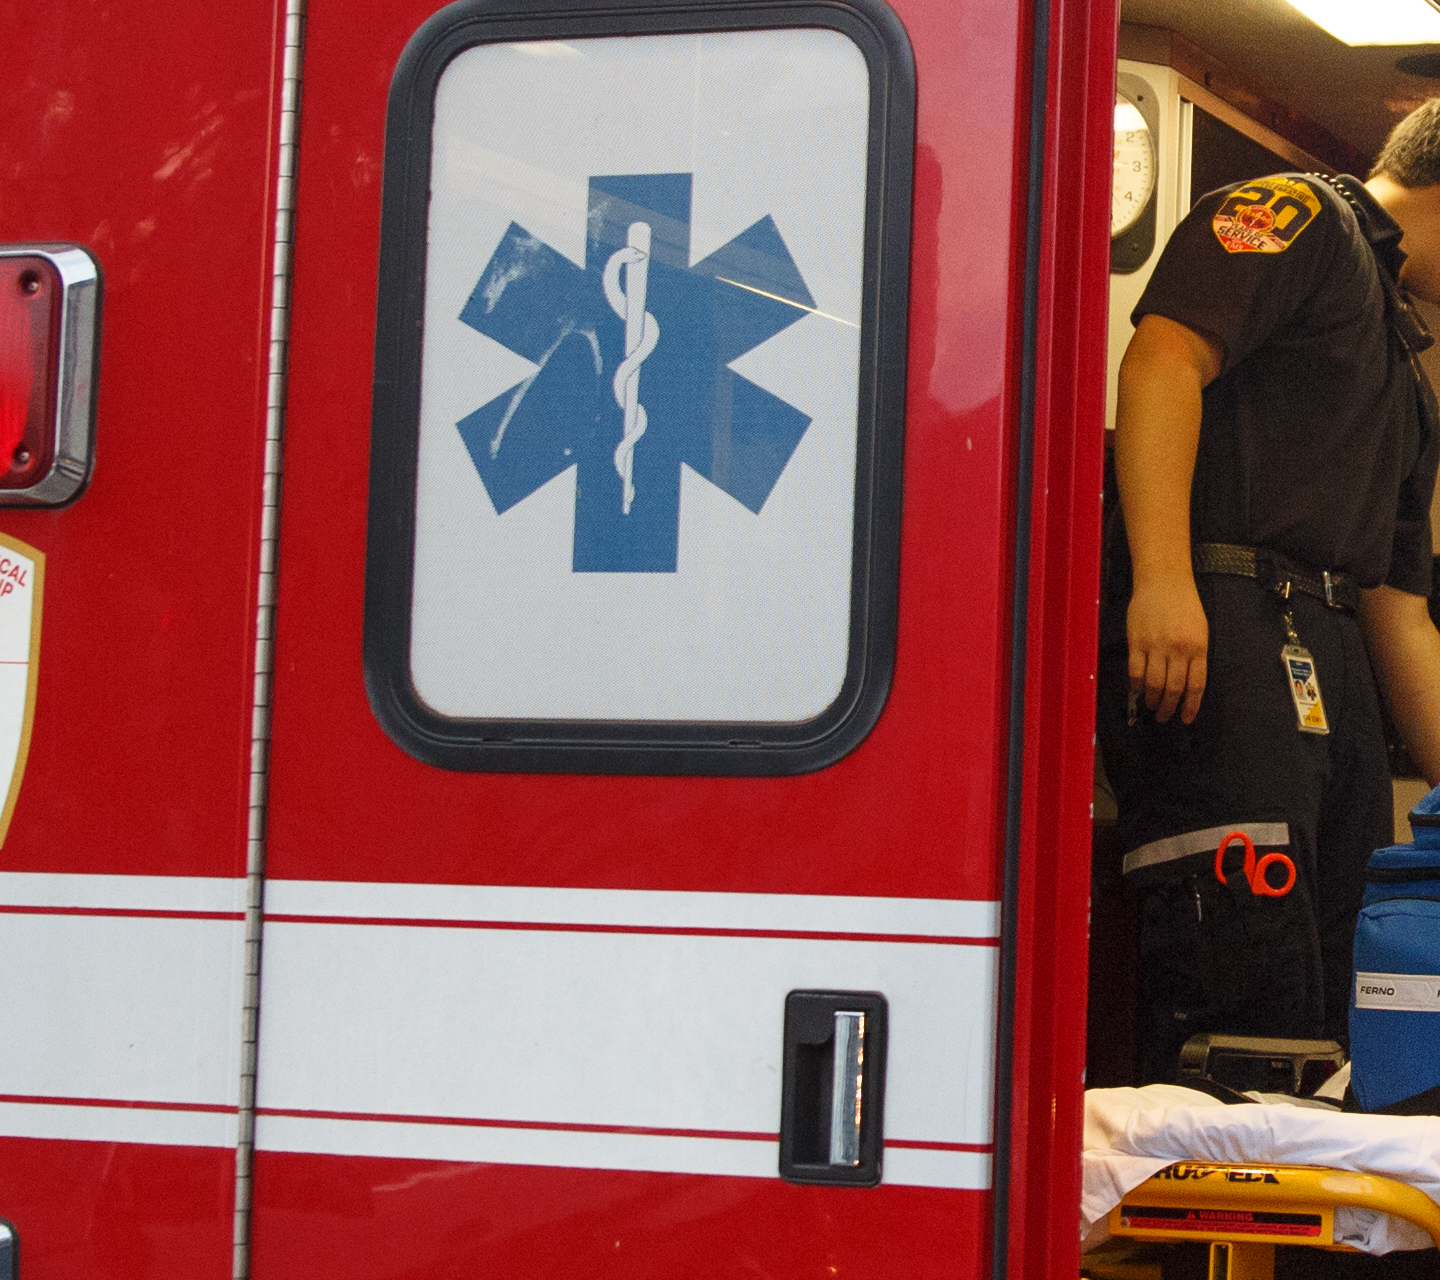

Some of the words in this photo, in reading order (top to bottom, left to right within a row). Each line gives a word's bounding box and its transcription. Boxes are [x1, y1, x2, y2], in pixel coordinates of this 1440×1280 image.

[1126, 132, 1135, 142] 2
[1133, 161, 1141, 172] 3
[1124, 191, 1133, 201] 4
[1217, 186, 1312, 241] 20
[1217, 225, 1267, 250] SERVICE
[1360, 985, 1394, 996] FERNO
[1199, 1210, 1254, 1222] WARNING
